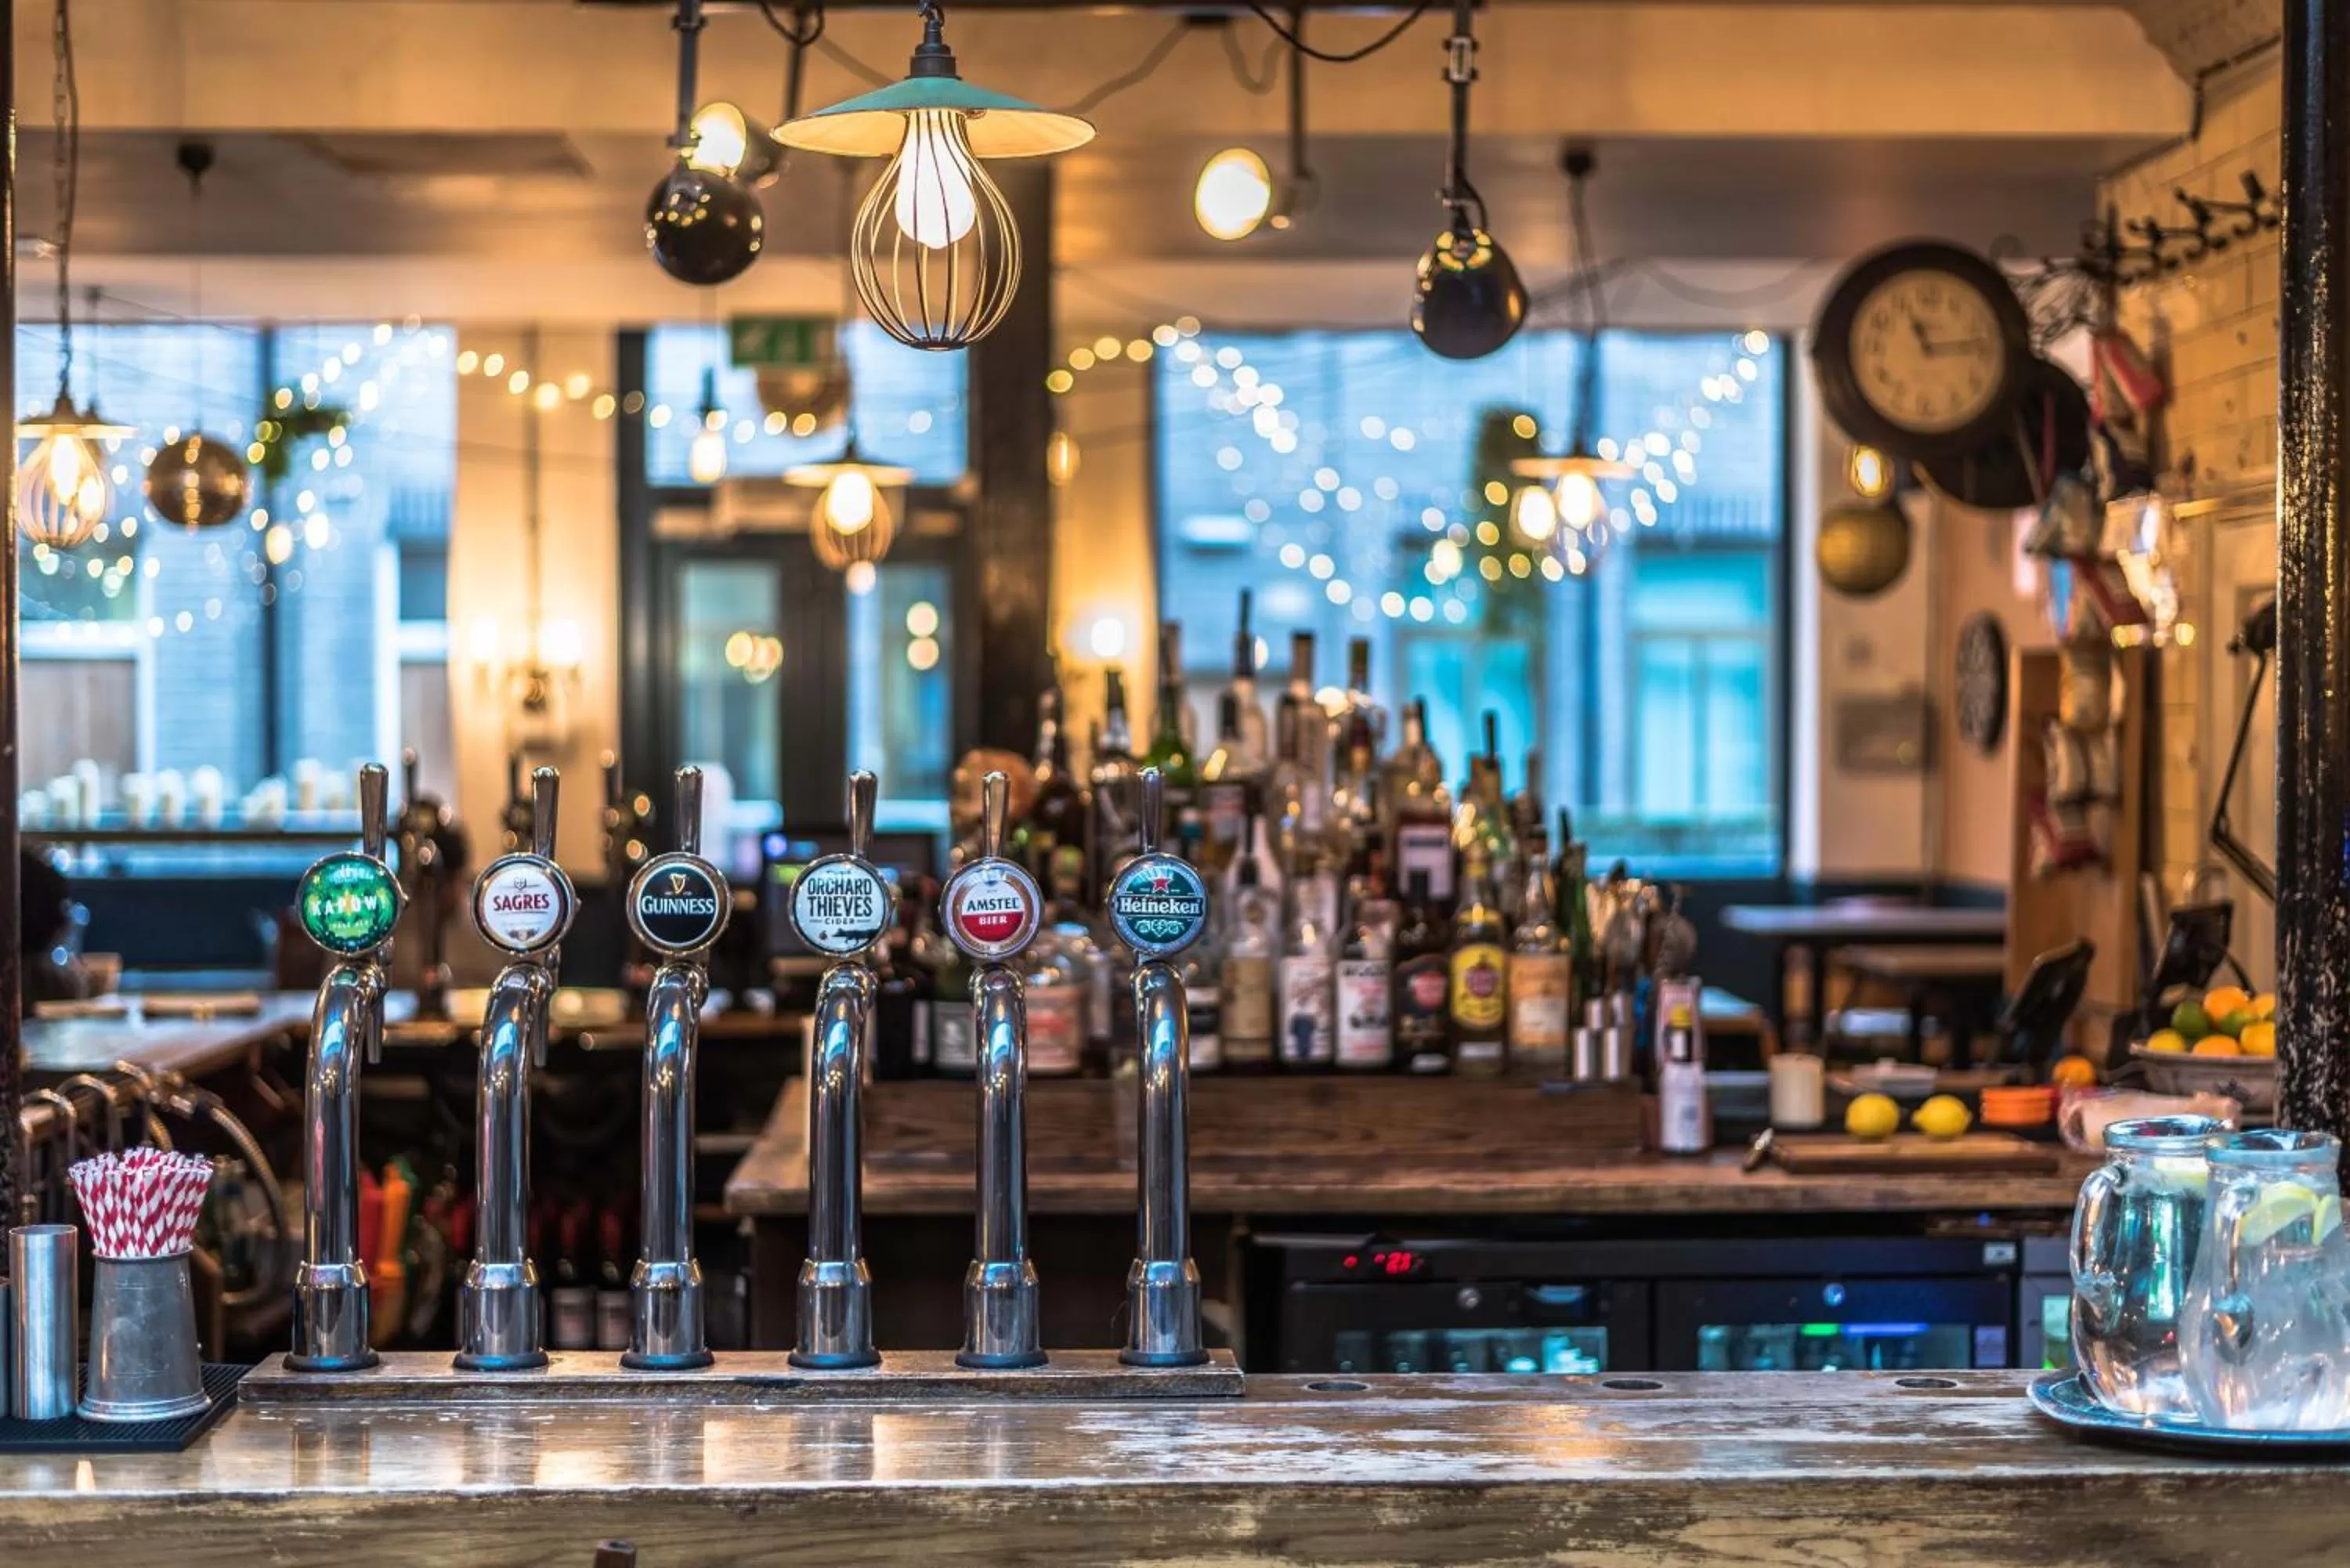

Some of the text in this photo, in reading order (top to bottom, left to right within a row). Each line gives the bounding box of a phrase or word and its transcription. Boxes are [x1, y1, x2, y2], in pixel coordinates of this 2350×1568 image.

[808, 878, 872, 895] ORCHARD
[493, 893, 550, 912] SAGRES
[642, 895, 714, 915] GUINNESS
[807, 896, 873, 917] THIEVES
[967, 897, 1019, 911] AMSTEL
[1119, 897, 1200, 914] Heineken
[978, 915, 1007, 925] BIER
